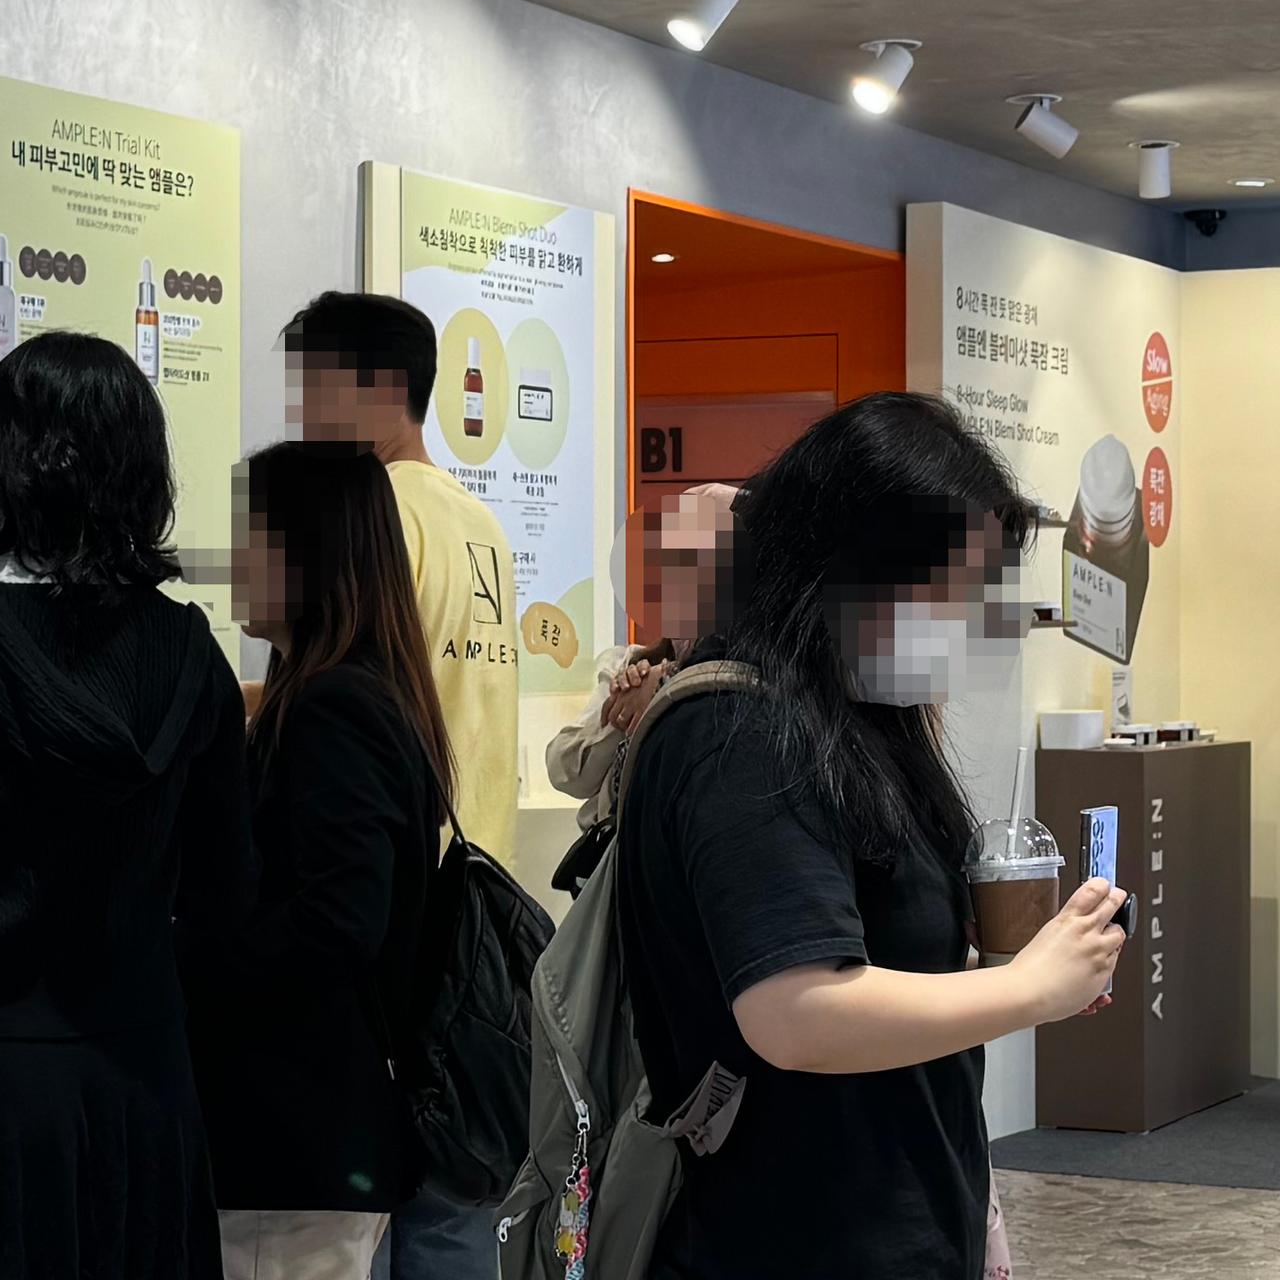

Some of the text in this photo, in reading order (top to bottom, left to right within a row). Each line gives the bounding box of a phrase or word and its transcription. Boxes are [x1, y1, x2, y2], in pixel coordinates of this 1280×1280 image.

[51, 119, 161, 160] AMPLE:N Trial Kit
[12, 140, 194, 197] 내 피부고민에 딱 맞는 앰플은?
[419, 226, 477, 254] 색소침착으로
[480, 237, 506, 261] 칙칙한
[509, 244, 535, 268] 피부를
[558, 252, 583, 276] 환하게
[956, 286, 979, 313] 8시간
[956, 325, 987, 359] 앰플엔
[990, 332, 1028, 367] 블레미샷
[1051, 347, 1069, 375] 크림
[1146, 349, 1169, 374] Slow
[986, 389, 1008, 414] Sleep
[1009, 394, 1029, 413] Glow
[641, 427, 682, 473] B1
[1151, 798, 1163, 1019] AMPLE:N
